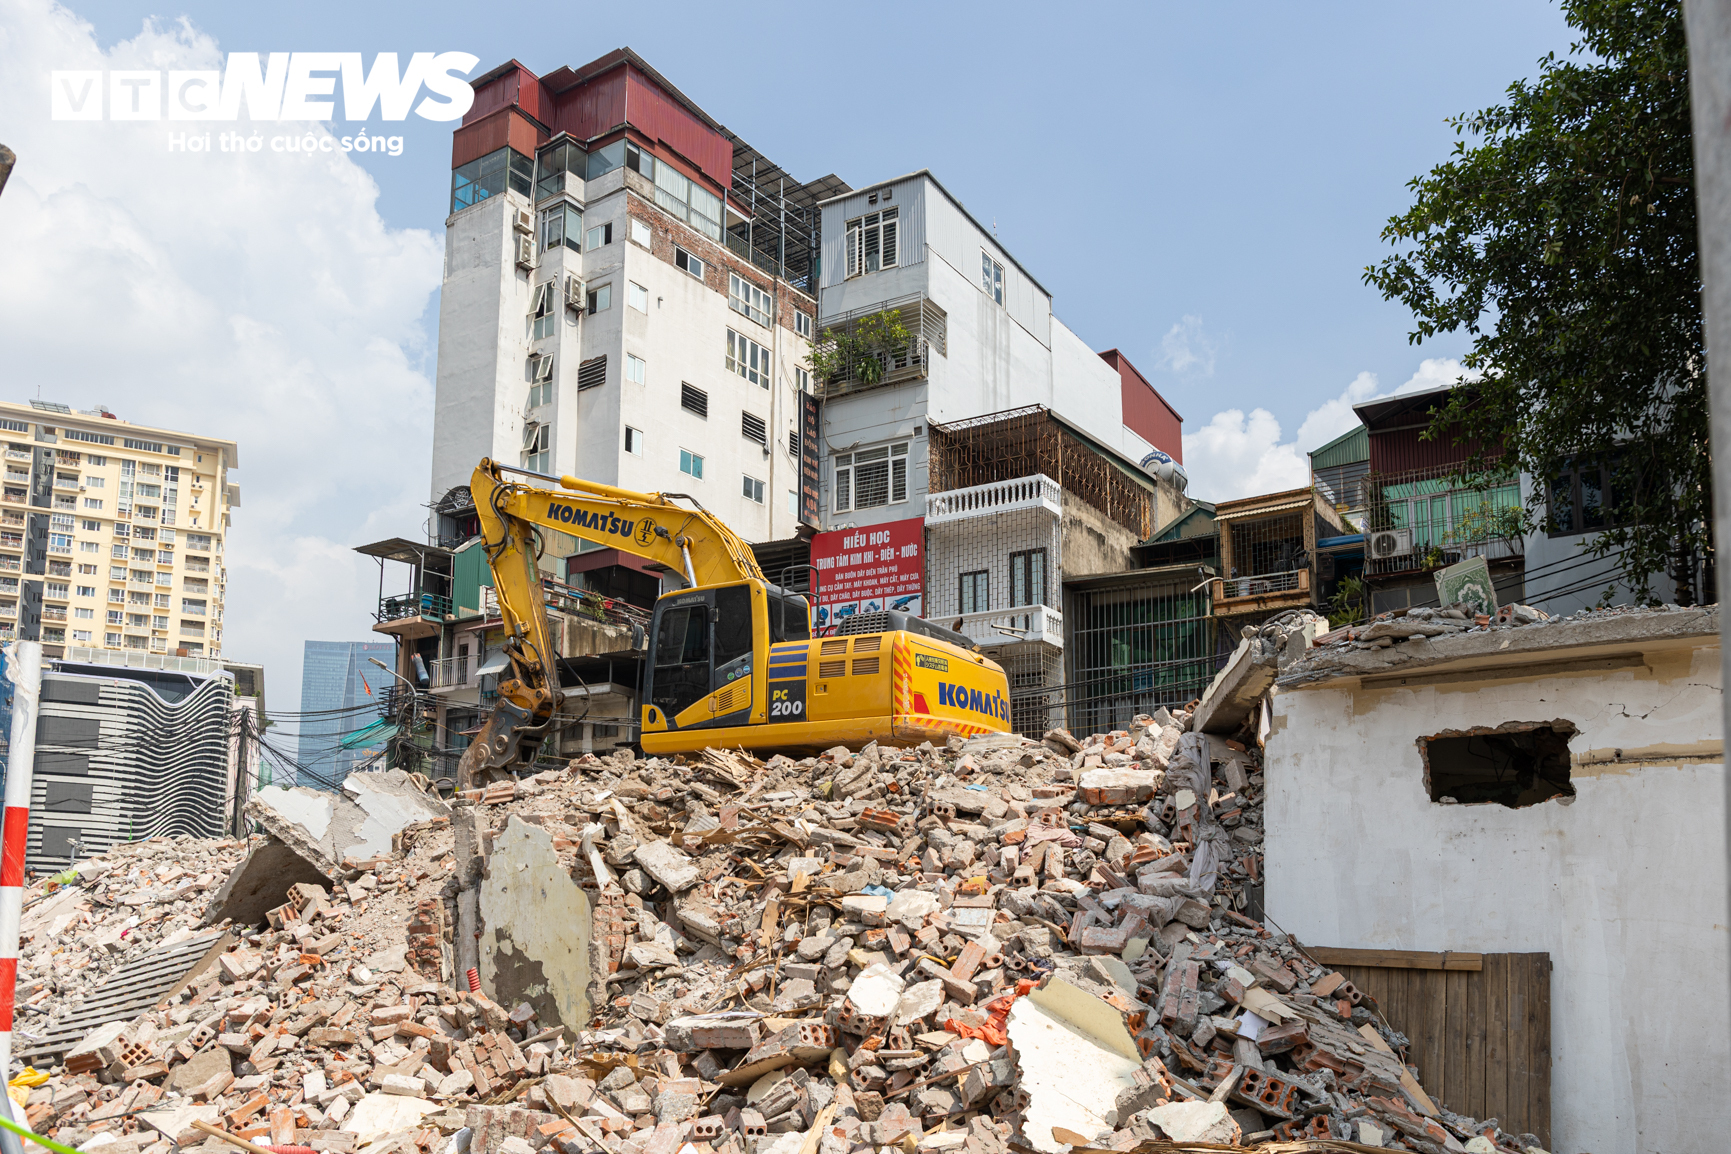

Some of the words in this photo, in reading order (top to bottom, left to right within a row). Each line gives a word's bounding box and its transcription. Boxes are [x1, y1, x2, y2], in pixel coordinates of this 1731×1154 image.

[546, 502, 635, 538] KOMATSU
[843, 531, 866, 550] HIẾU
[869, 530, 890, 547] HỌC
[816, 556, 835, 570] TRUNG
[836, 553, 849, 567] TÂM
[850, 552, 862, 566] KIM
[880, 546, 894, 563] ĐIỆN
[901, 542, 918, 558] NƯỚC
[772, 689, 788, 701] PC
[938, 681, 1010, 724] KOMATSU
[771, 701, 803, 716] 200
